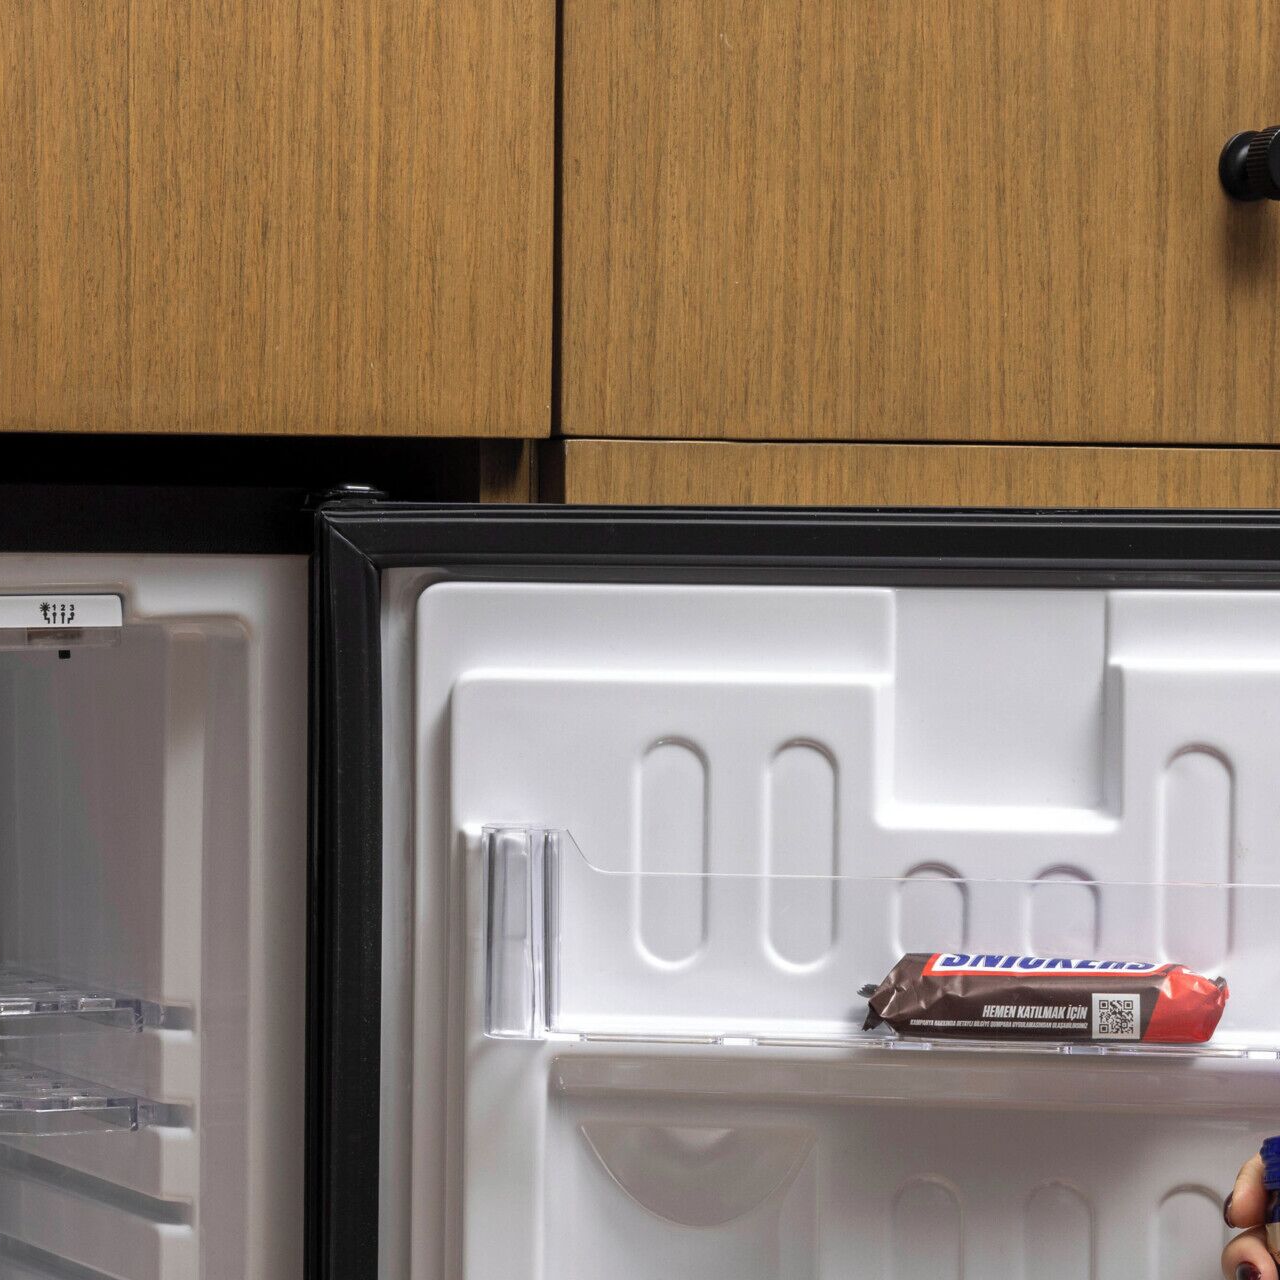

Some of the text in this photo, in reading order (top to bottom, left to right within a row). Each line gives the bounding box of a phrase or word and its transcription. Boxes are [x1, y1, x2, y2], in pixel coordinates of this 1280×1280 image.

[982, 1004, 1088, 1021] HEMEN KATILMAK İÇİN
